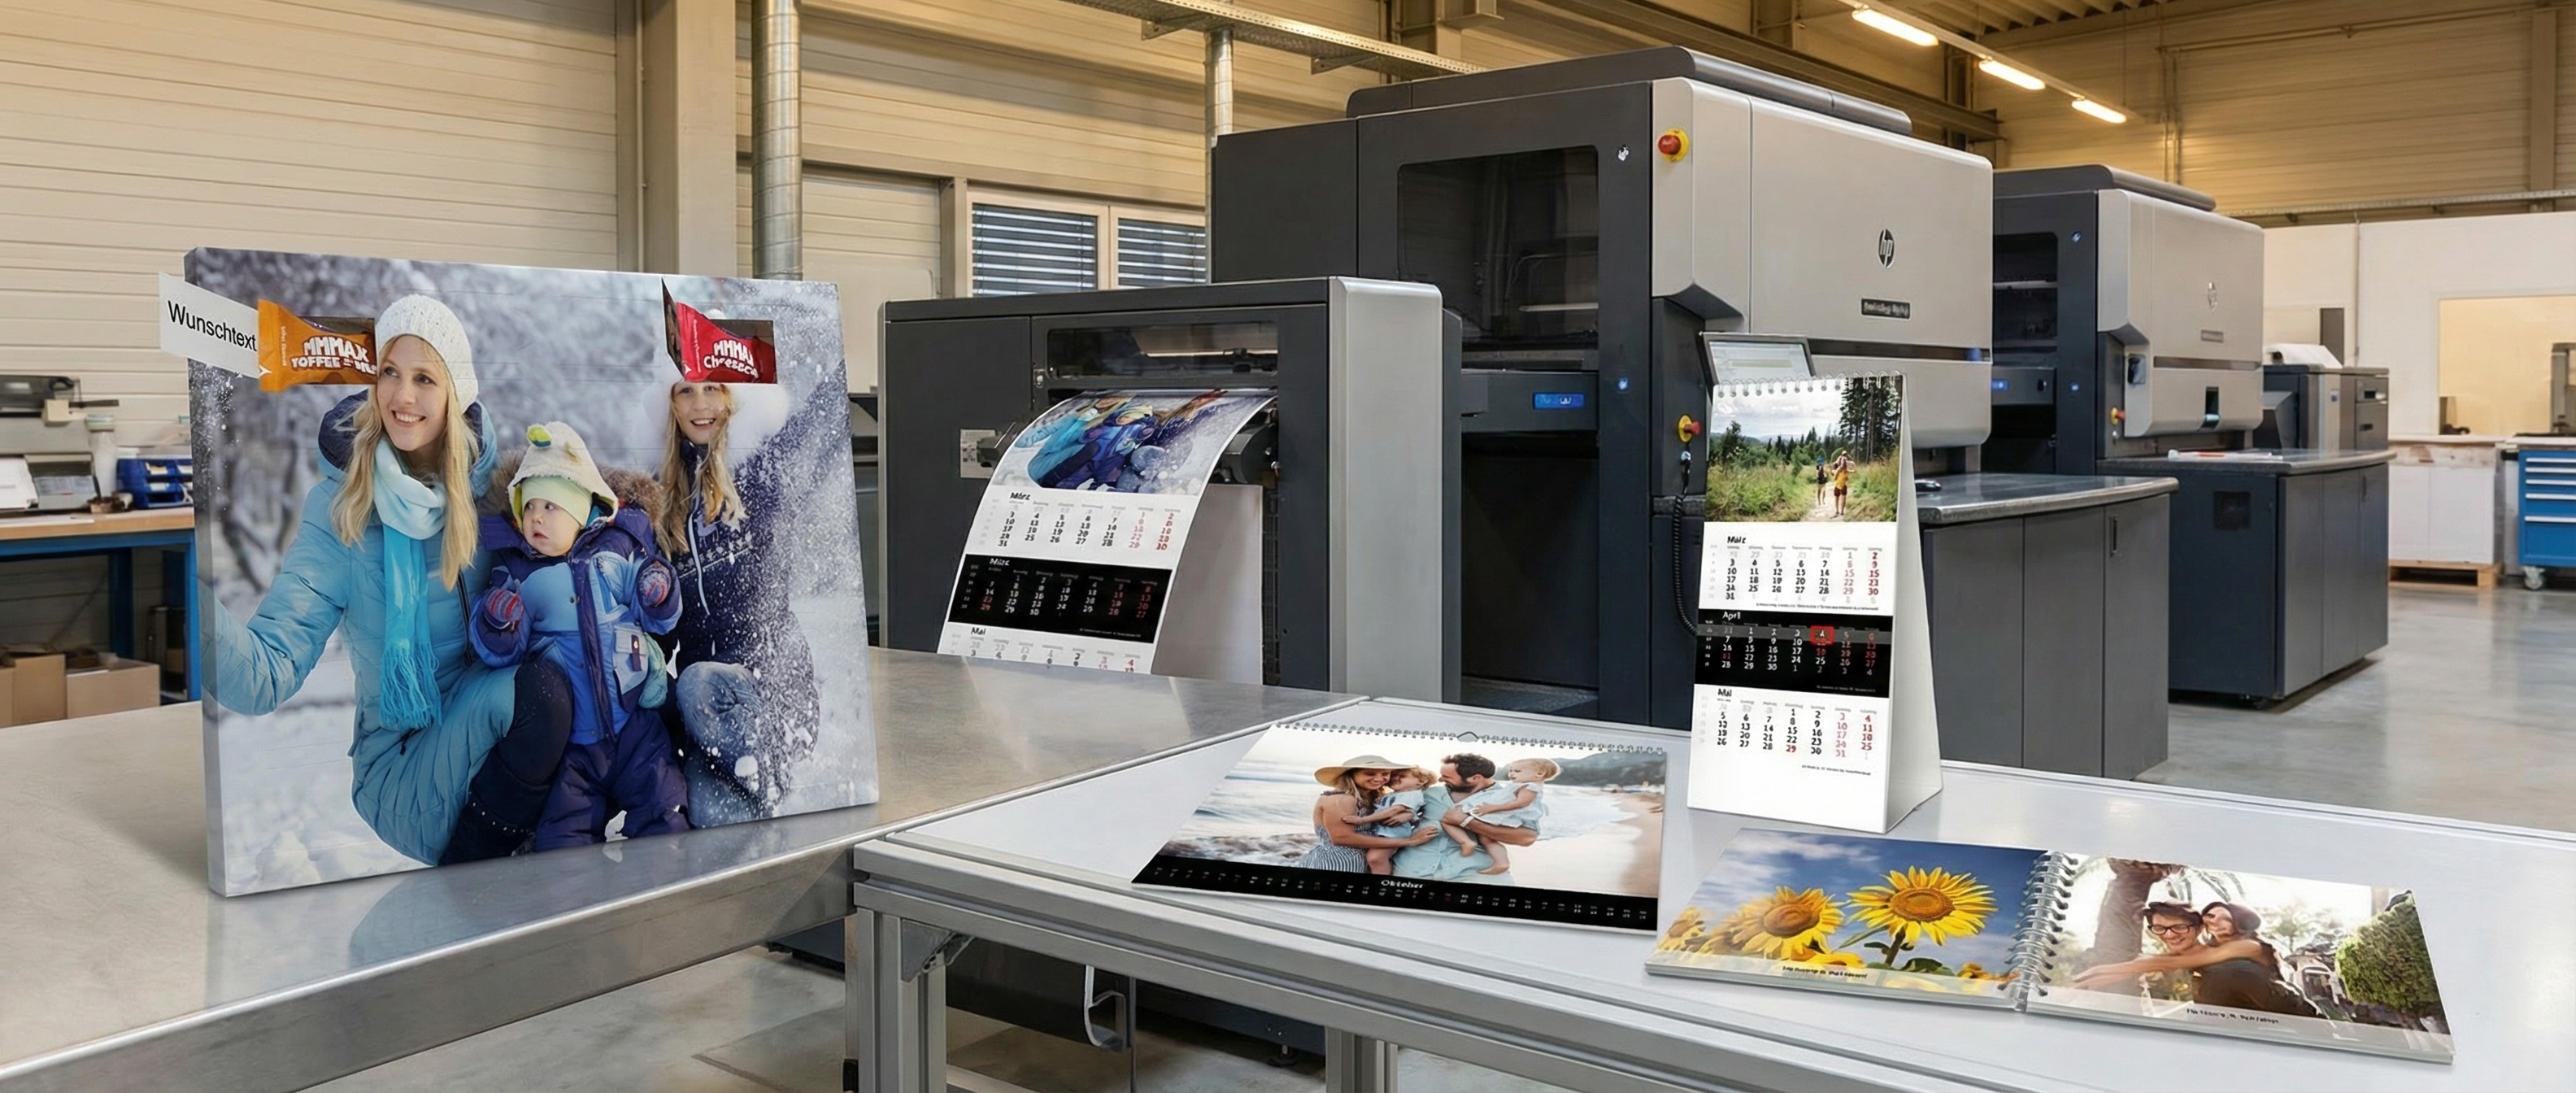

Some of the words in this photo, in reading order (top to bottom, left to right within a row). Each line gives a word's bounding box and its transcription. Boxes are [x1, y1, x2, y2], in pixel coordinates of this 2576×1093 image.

[168, 300, 257, 351] Wunschtext
[303, 336, 370, 363] MMMAX
[1725, 592, 1734, 600] 31
[1868, 587, 1878, 595] 30
[1743, 713, 1748, 721] 6
[1790, 717, 1795, 725] 8
[1814, 720, 1820, 728] 9
[1838, 722, 1847, 730] 10
[1863, 724, 1873, 732] 11
[1788, 726, 1798, 734] 15
[1740, 731, 1750, 739] 20
[1763, 733, 1773, 742] 21
[1786, 735, 1797, 743] 22
[1763, 742, 1773, 750] 28
